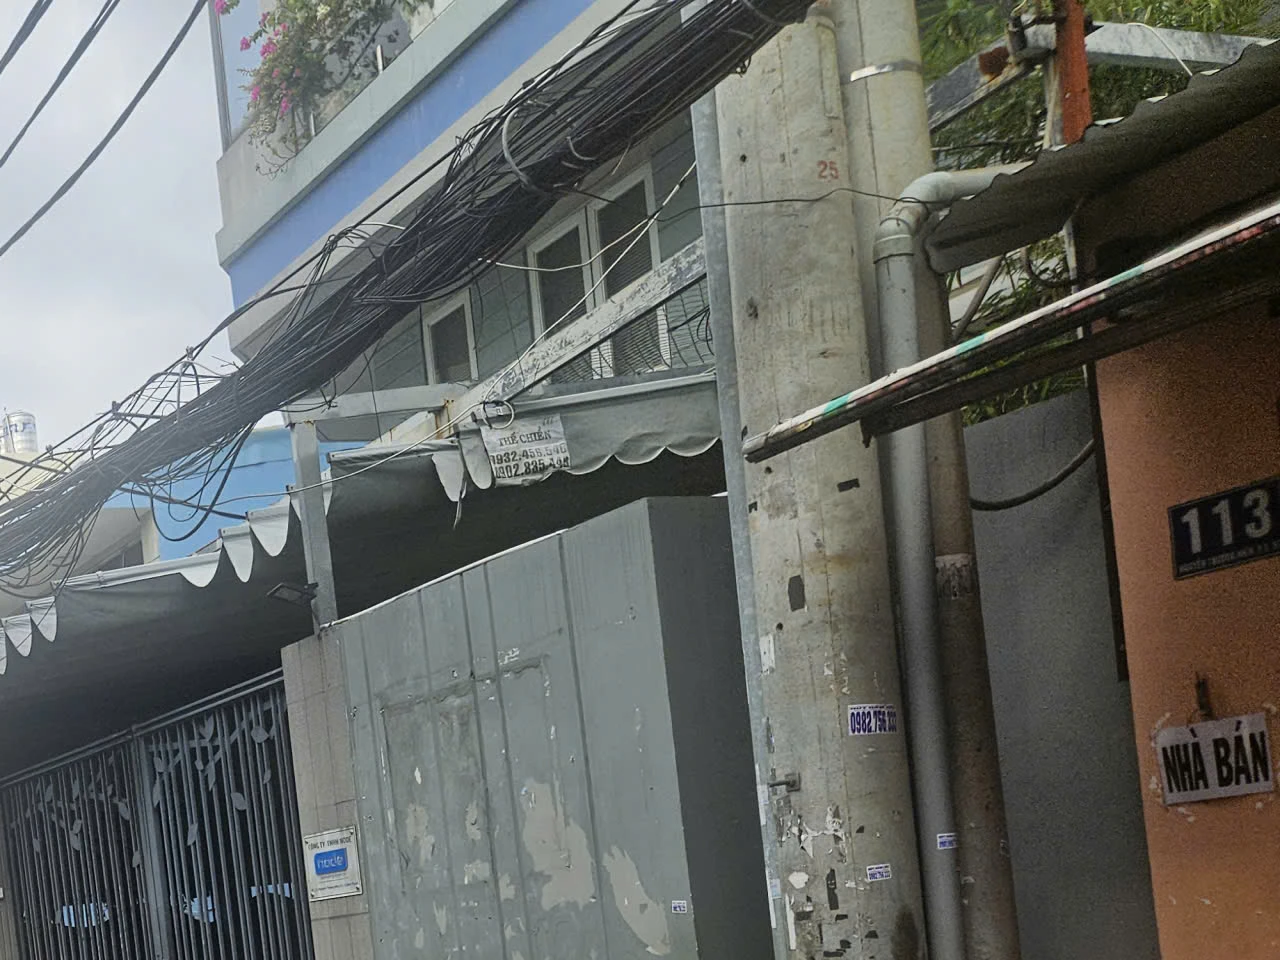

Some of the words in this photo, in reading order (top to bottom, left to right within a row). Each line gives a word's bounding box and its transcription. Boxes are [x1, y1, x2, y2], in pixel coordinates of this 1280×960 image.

[816, 160, 840, 180] 25
[1181, 489, 1272, 554] 113
[1162, 727, 1209, 793] NHÀ
[1212, 720, 1269, 787] BÁN
